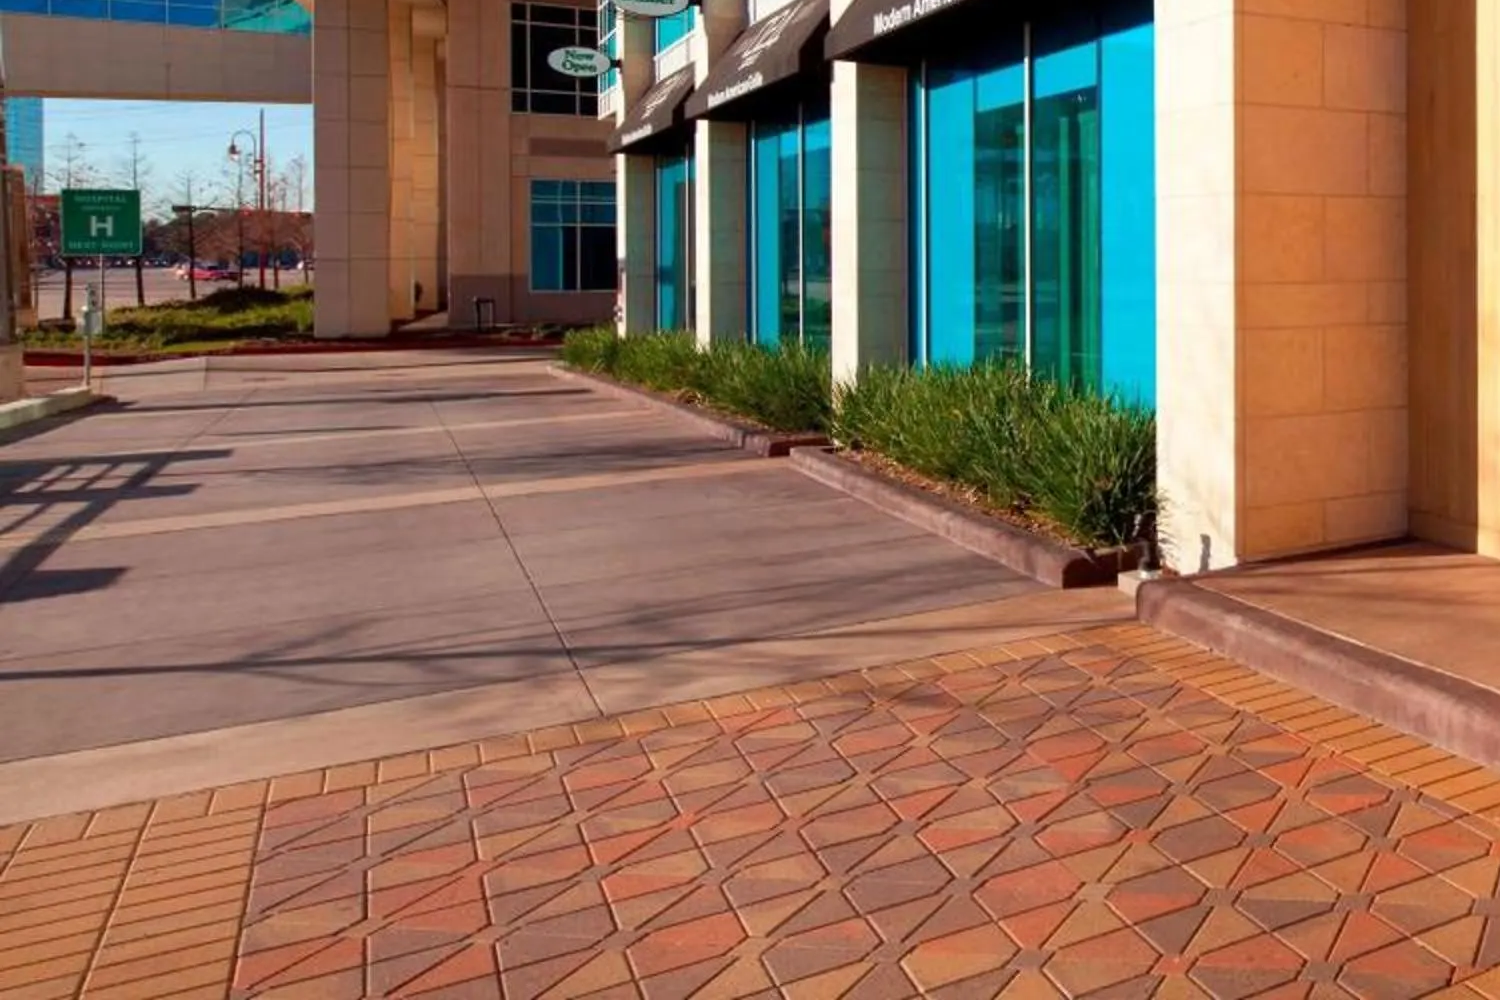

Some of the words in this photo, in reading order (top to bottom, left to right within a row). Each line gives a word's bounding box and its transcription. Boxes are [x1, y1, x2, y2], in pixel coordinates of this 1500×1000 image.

[873, 4, 912, 36] Modern
[564, 50, 595, 60] Now
[562, 59, 597, 73] Open
[90, 215, 114, 237] H
